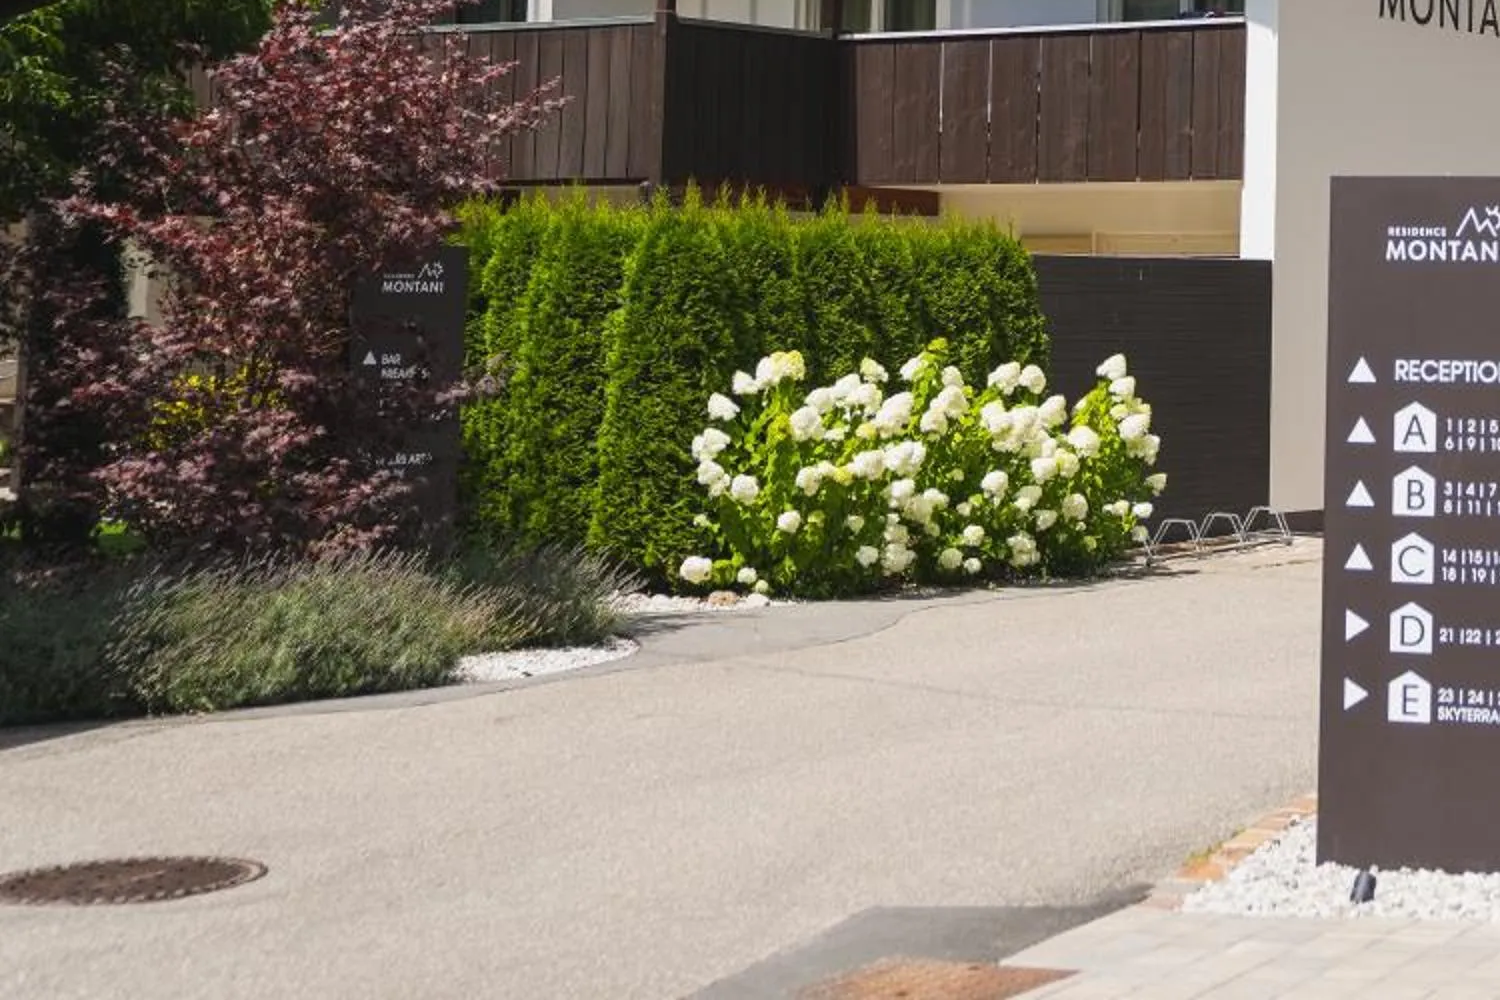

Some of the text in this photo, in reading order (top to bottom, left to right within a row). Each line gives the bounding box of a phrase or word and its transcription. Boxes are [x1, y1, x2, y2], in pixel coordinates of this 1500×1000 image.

[1387, 226, 1447, 237] RESIDENCE
[383, 280, 444, 294] MONTANI
[381, 353, 401, 365] BAR
[1402, 414, 1427, 445] A
[1467, 418, 1477, 433] 2
[1406, 479, 1426, 510] B
[1465, 482, 1475, 497] 4
[1488, 482, 1497, 498] 7
[1399, 545, 1425, 577] C
[1442, 548, 1457, 564] 14
[1400, 615, 1425, 647] D
[1439, 627, 1454, 643] 21
[1465, 628, 1481, 644] 22
[1403, 685, 1420, 716] E
[1467, 689, 1484, 705] 24
